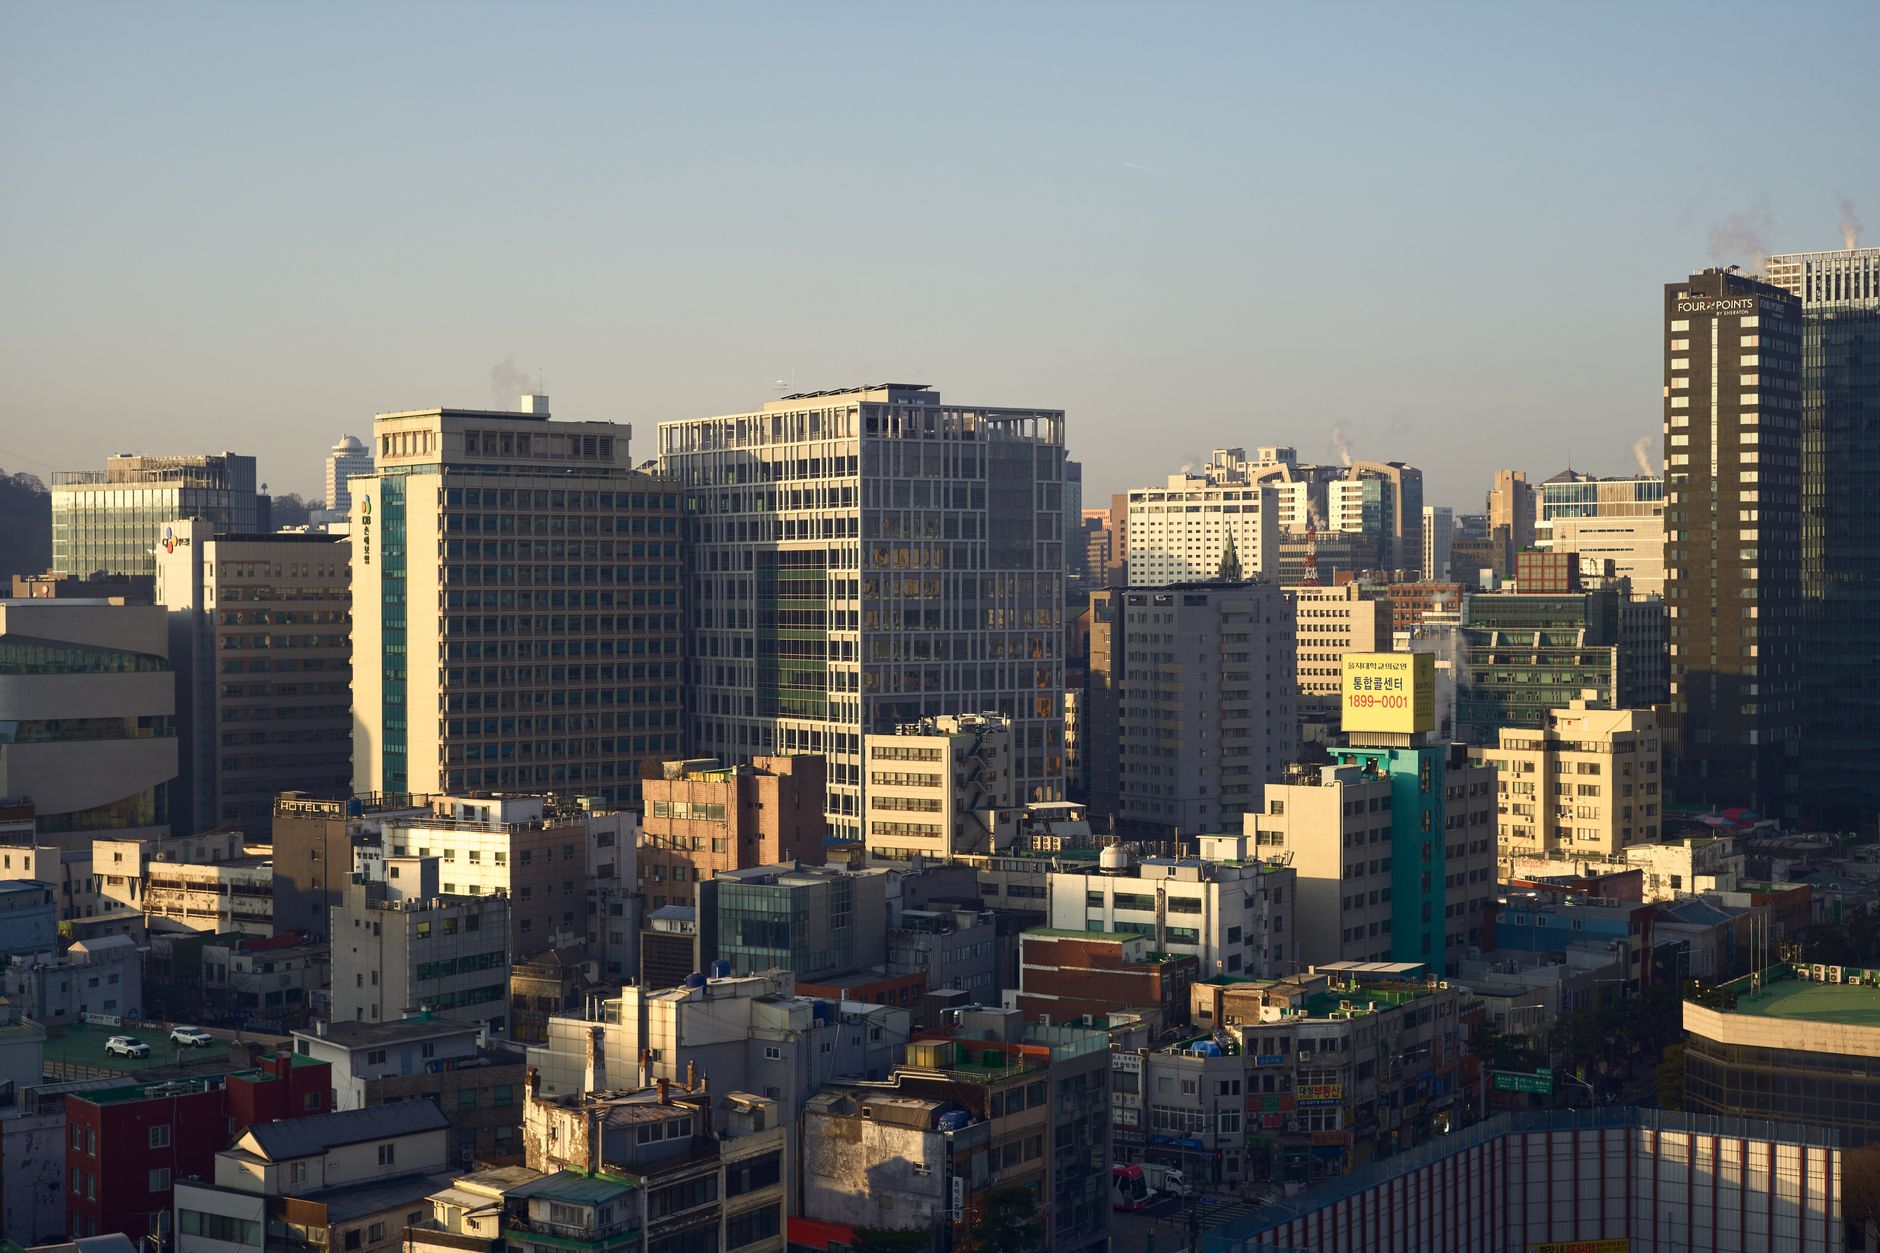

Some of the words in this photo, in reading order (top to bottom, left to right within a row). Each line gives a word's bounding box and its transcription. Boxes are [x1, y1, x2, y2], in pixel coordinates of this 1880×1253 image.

[1678, 301, 1705, 312] FOUR
[1716, 298, 1753, 310] POINTS
[362, 516, 371, 525] DB
[1348, 662, 1407, 670] 을지대학교의료원
[1353, 676, 1403, 691] 통합콜센터
[1348, 694, 1408, 708] 1899-0001
[280, 800, 320, 813] HOTEL
